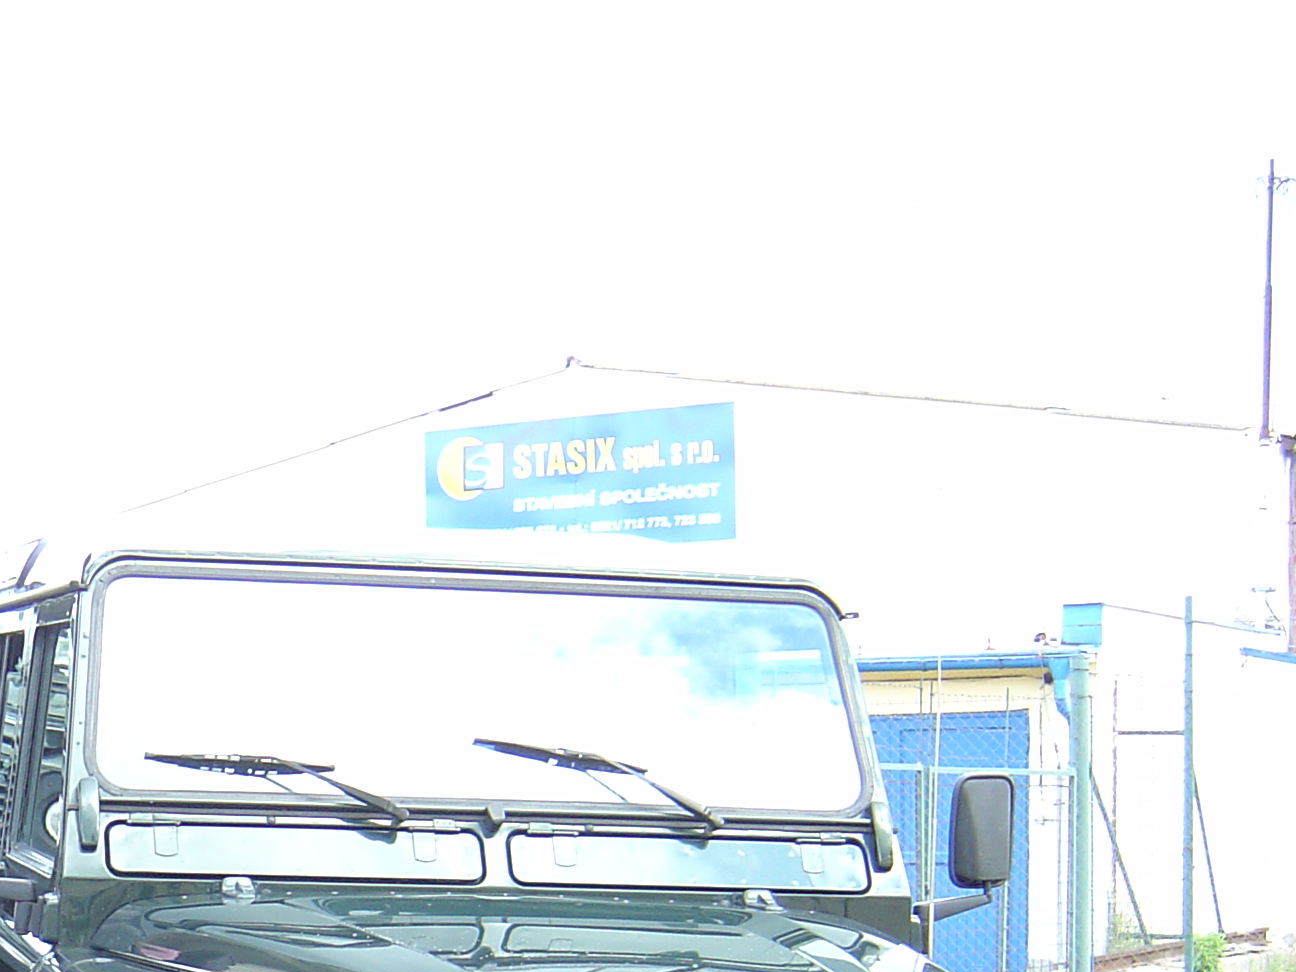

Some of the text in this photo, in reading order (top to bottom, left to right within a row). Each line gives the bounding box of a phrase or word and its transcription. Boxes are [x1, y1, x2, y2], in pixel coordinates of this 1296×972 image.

[512, 436, 720, 480] STASIX spol. s r.o.
[599, 482, 721, 506] SPOLEČNOST
